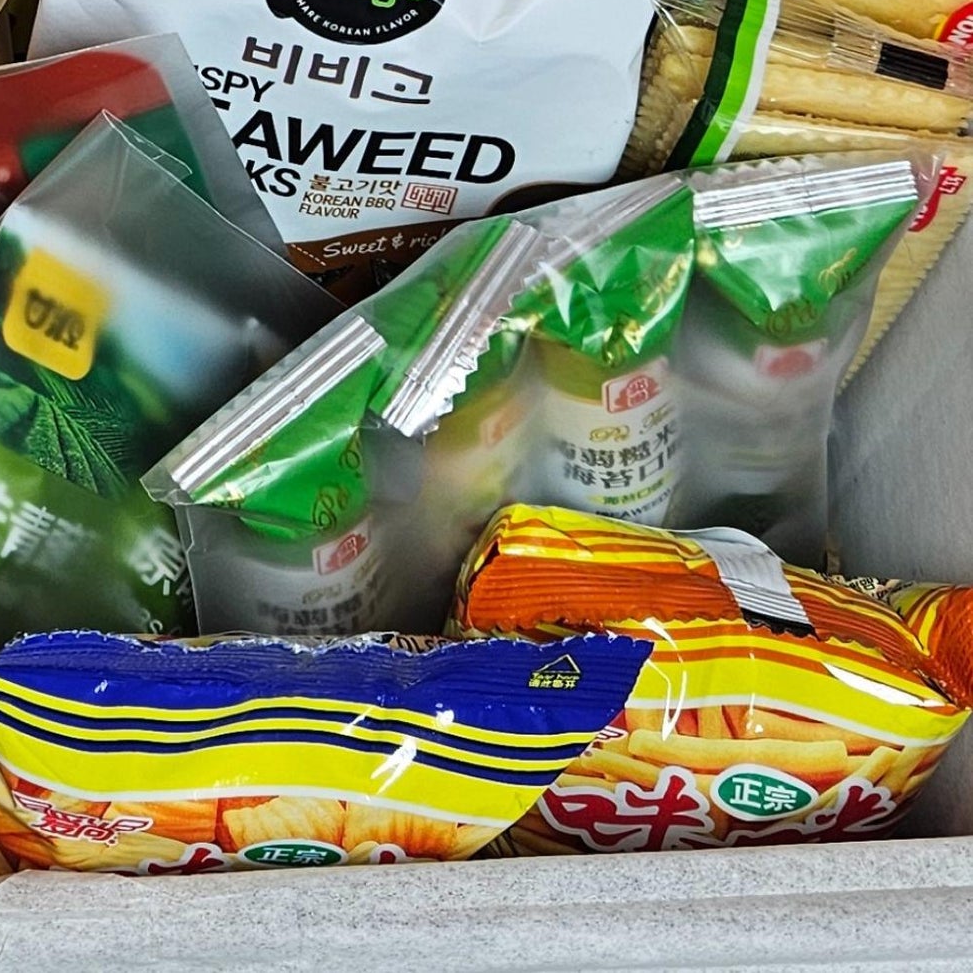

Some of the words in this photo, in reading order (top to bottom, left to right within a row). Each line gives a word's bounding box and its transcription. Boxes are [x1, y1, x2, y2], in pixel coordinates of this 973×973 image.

[322, 20, 371, 36] KOREAN
[375, 8, 419, 35] FLAVOR
[193, 64, 276, 103] SPY
[242, 35, 434, 105] 비비고
[210, 96, 516, 185] AWEED
[308, 174, 403, 196] 불고기맛
[298, 203, 361, 219] FLAVOUR
[302, 191, 364, 208] KOREAN
[364, 197, 397, 211] BBQ
[323, 231, 387, 258] Sweet
[391, 231, 405, 249] &
[729, 775, 797, 813] 正宗
[257, 847, 330, 868] 正宗
